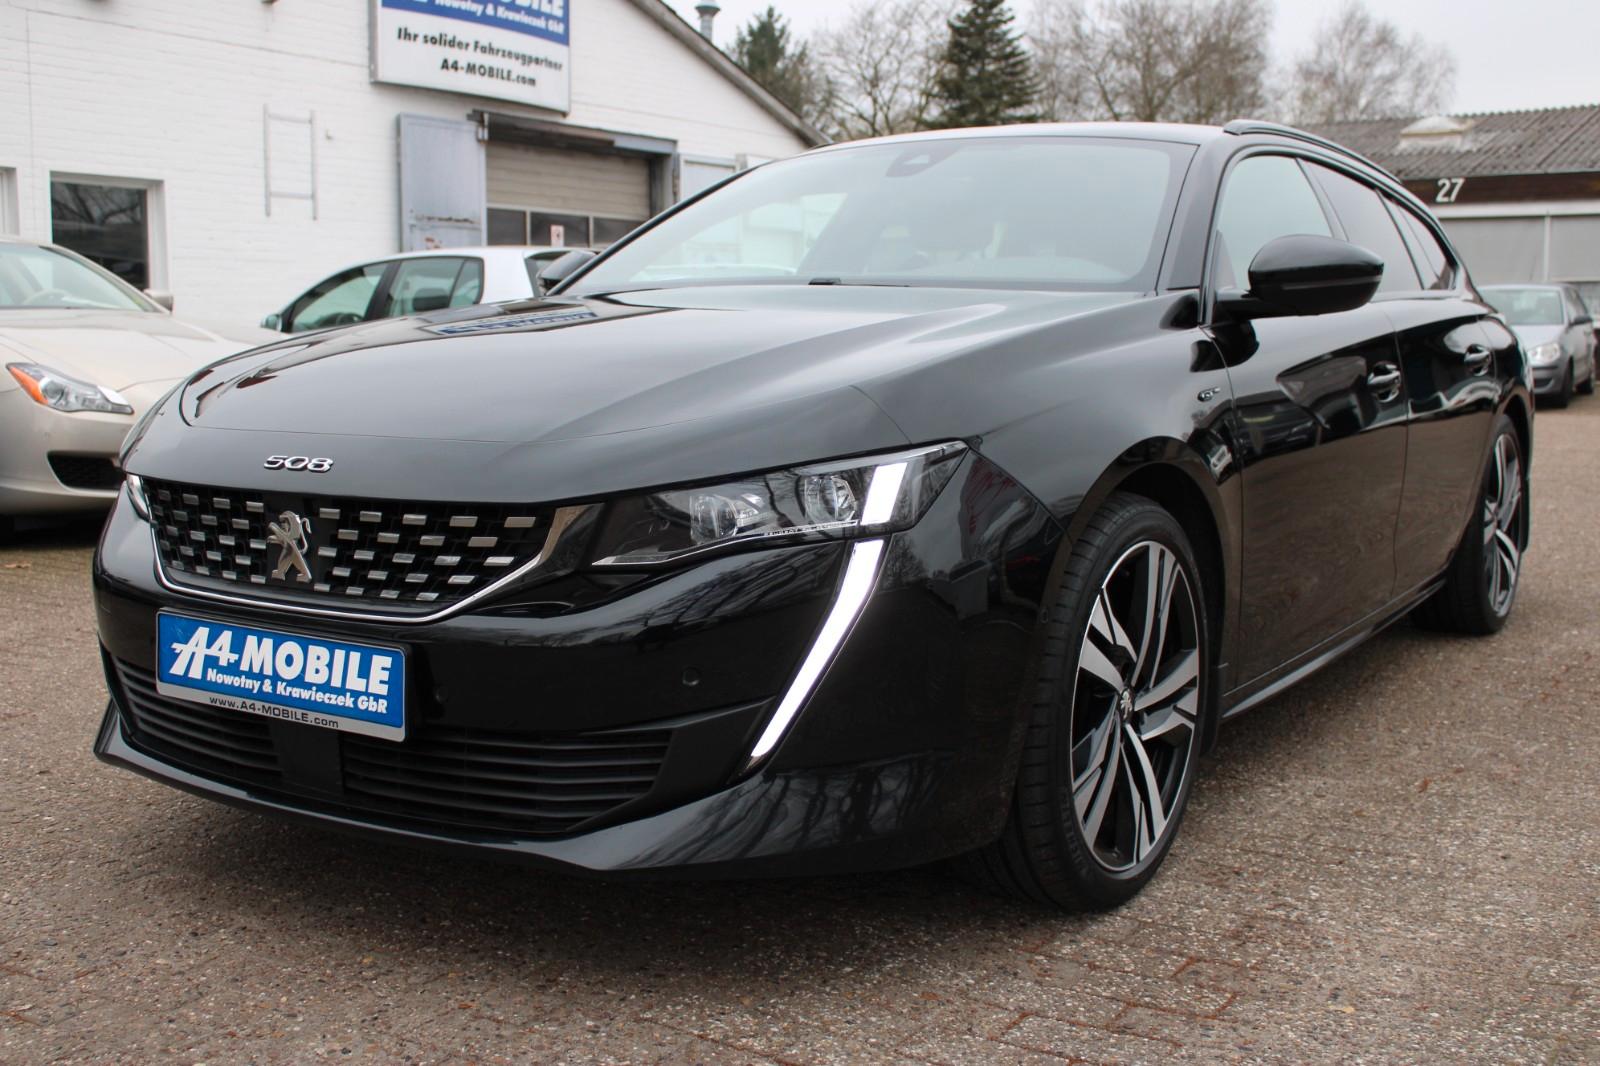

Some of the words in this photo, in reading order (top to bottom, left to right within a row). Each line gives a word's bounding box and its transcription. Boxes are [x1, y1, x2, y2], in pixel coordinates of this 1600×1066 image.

[397, 27, 419, 42] Ihr
[423, 32, 470, 51] solider
[473, 40, 563, 71] Fahrzeugpartner
[440, 58, 536, 87] A4-MOBILE.com
[1435, 178, 1465, 203] 27
[263, 455, 334, 472] 508
[206, 668, 261, 694] Nowotny
[262, 680, 273, 693] &
[276, 681, 354, 708] Krawieczek
[357, 696, 388, 714] GbR
[209, 695, 339, 729] www.A4-MOBILE.com
